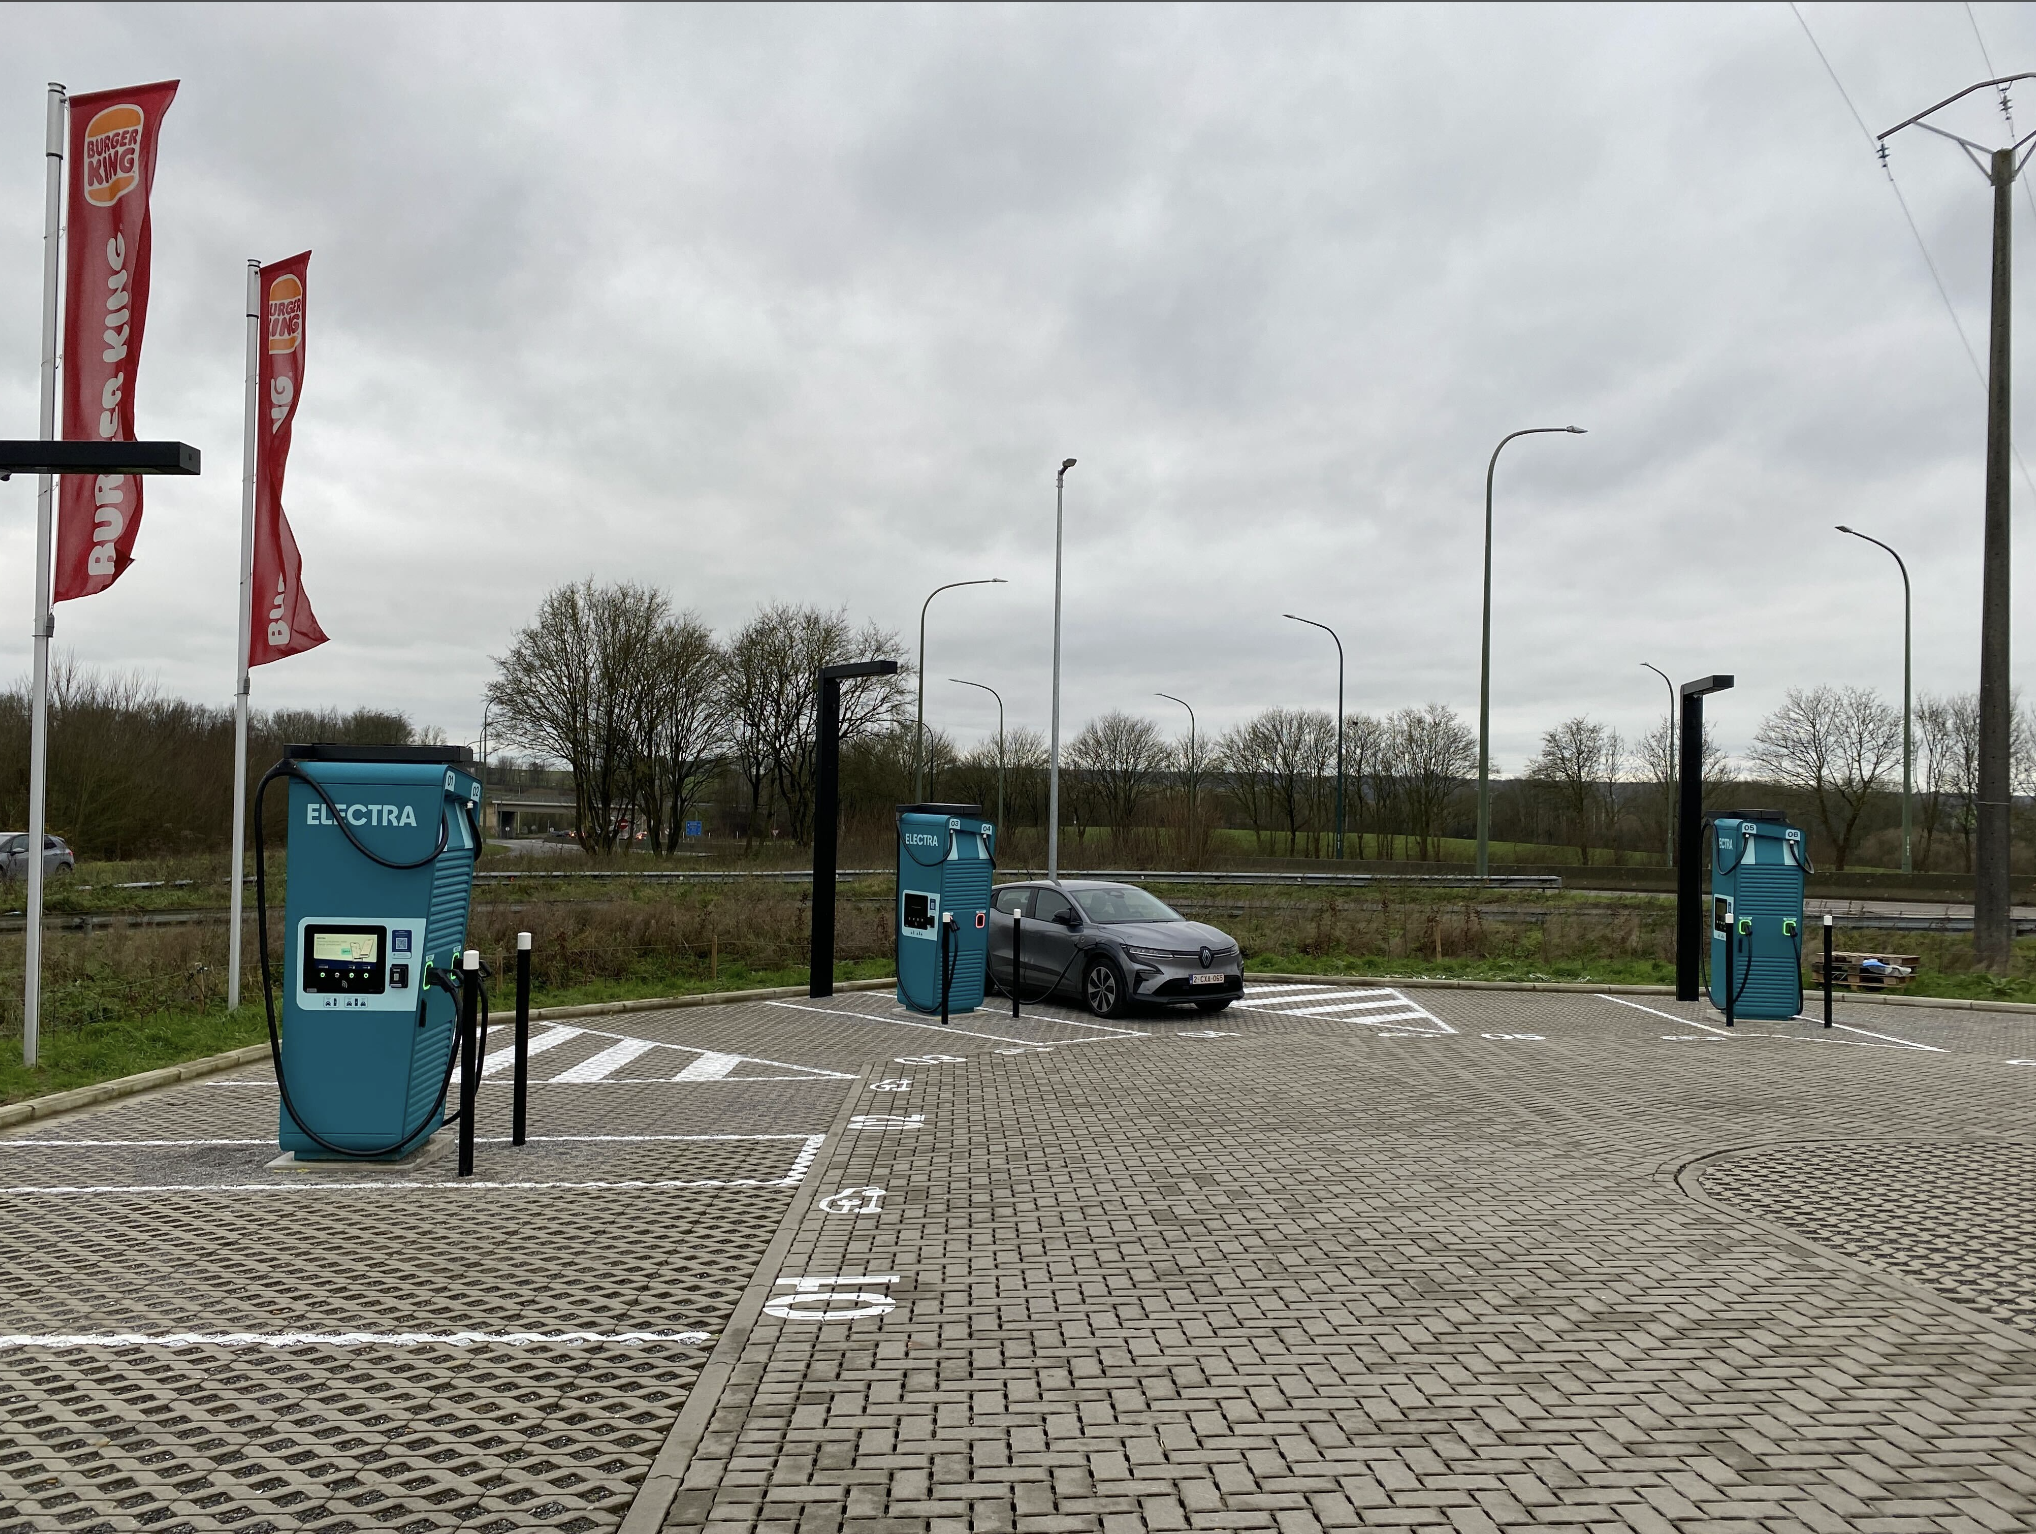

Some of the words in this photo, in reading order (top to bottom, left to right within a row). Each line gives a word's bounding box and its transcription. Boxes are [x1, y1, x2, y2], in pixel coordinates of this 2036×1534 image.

[87, 128, 139, 159] BURGER
[87, 147, 136, 187] KING
[103, 231, 130, 363] KING
[270, 299, 302, 317] URGER
[270, 316, 300, 337] ING
[87, 371, 124, 576] BURER
[306, 803, 418, 827] ELECTRA
[905, 833, 939, 847] ELECTRA
